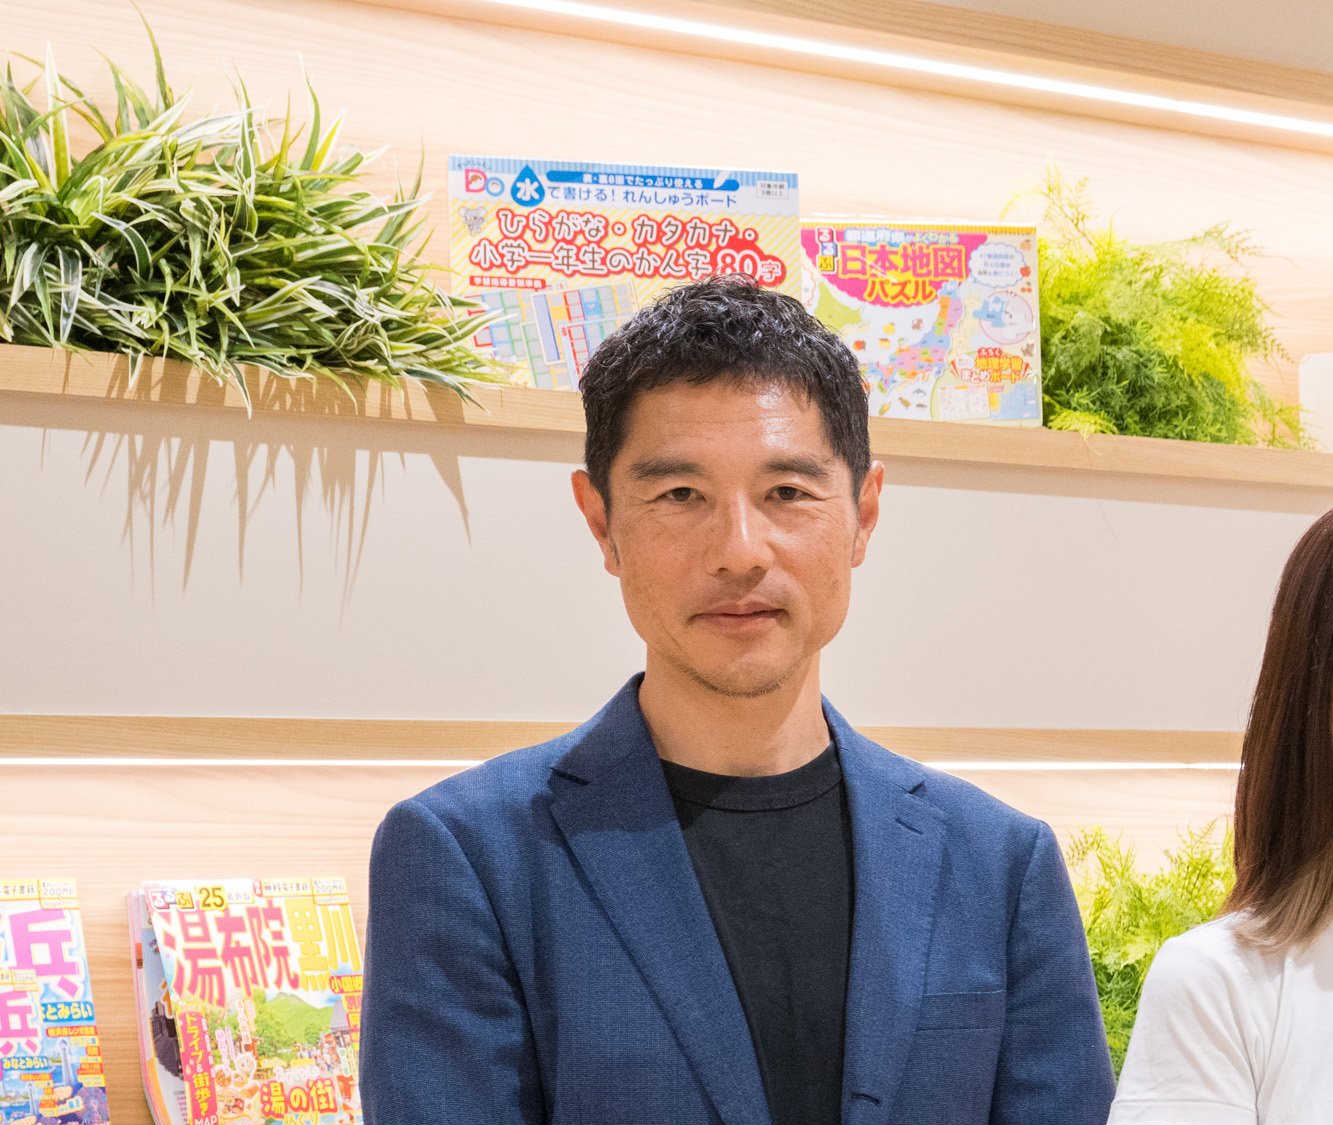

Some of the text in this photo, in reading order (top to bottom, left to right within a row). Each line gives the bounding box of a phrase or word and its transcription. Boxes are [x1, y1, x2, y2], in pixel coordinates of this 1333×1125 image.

[839, 243, 966, 281] 日本地図
[865, 278, 937, 304] パズル
[199, 887, 225, 908] 25
[157, 898, 362, 1008] 湯布院 黒川
[262, 1080, 335, 1117] 湯の街
